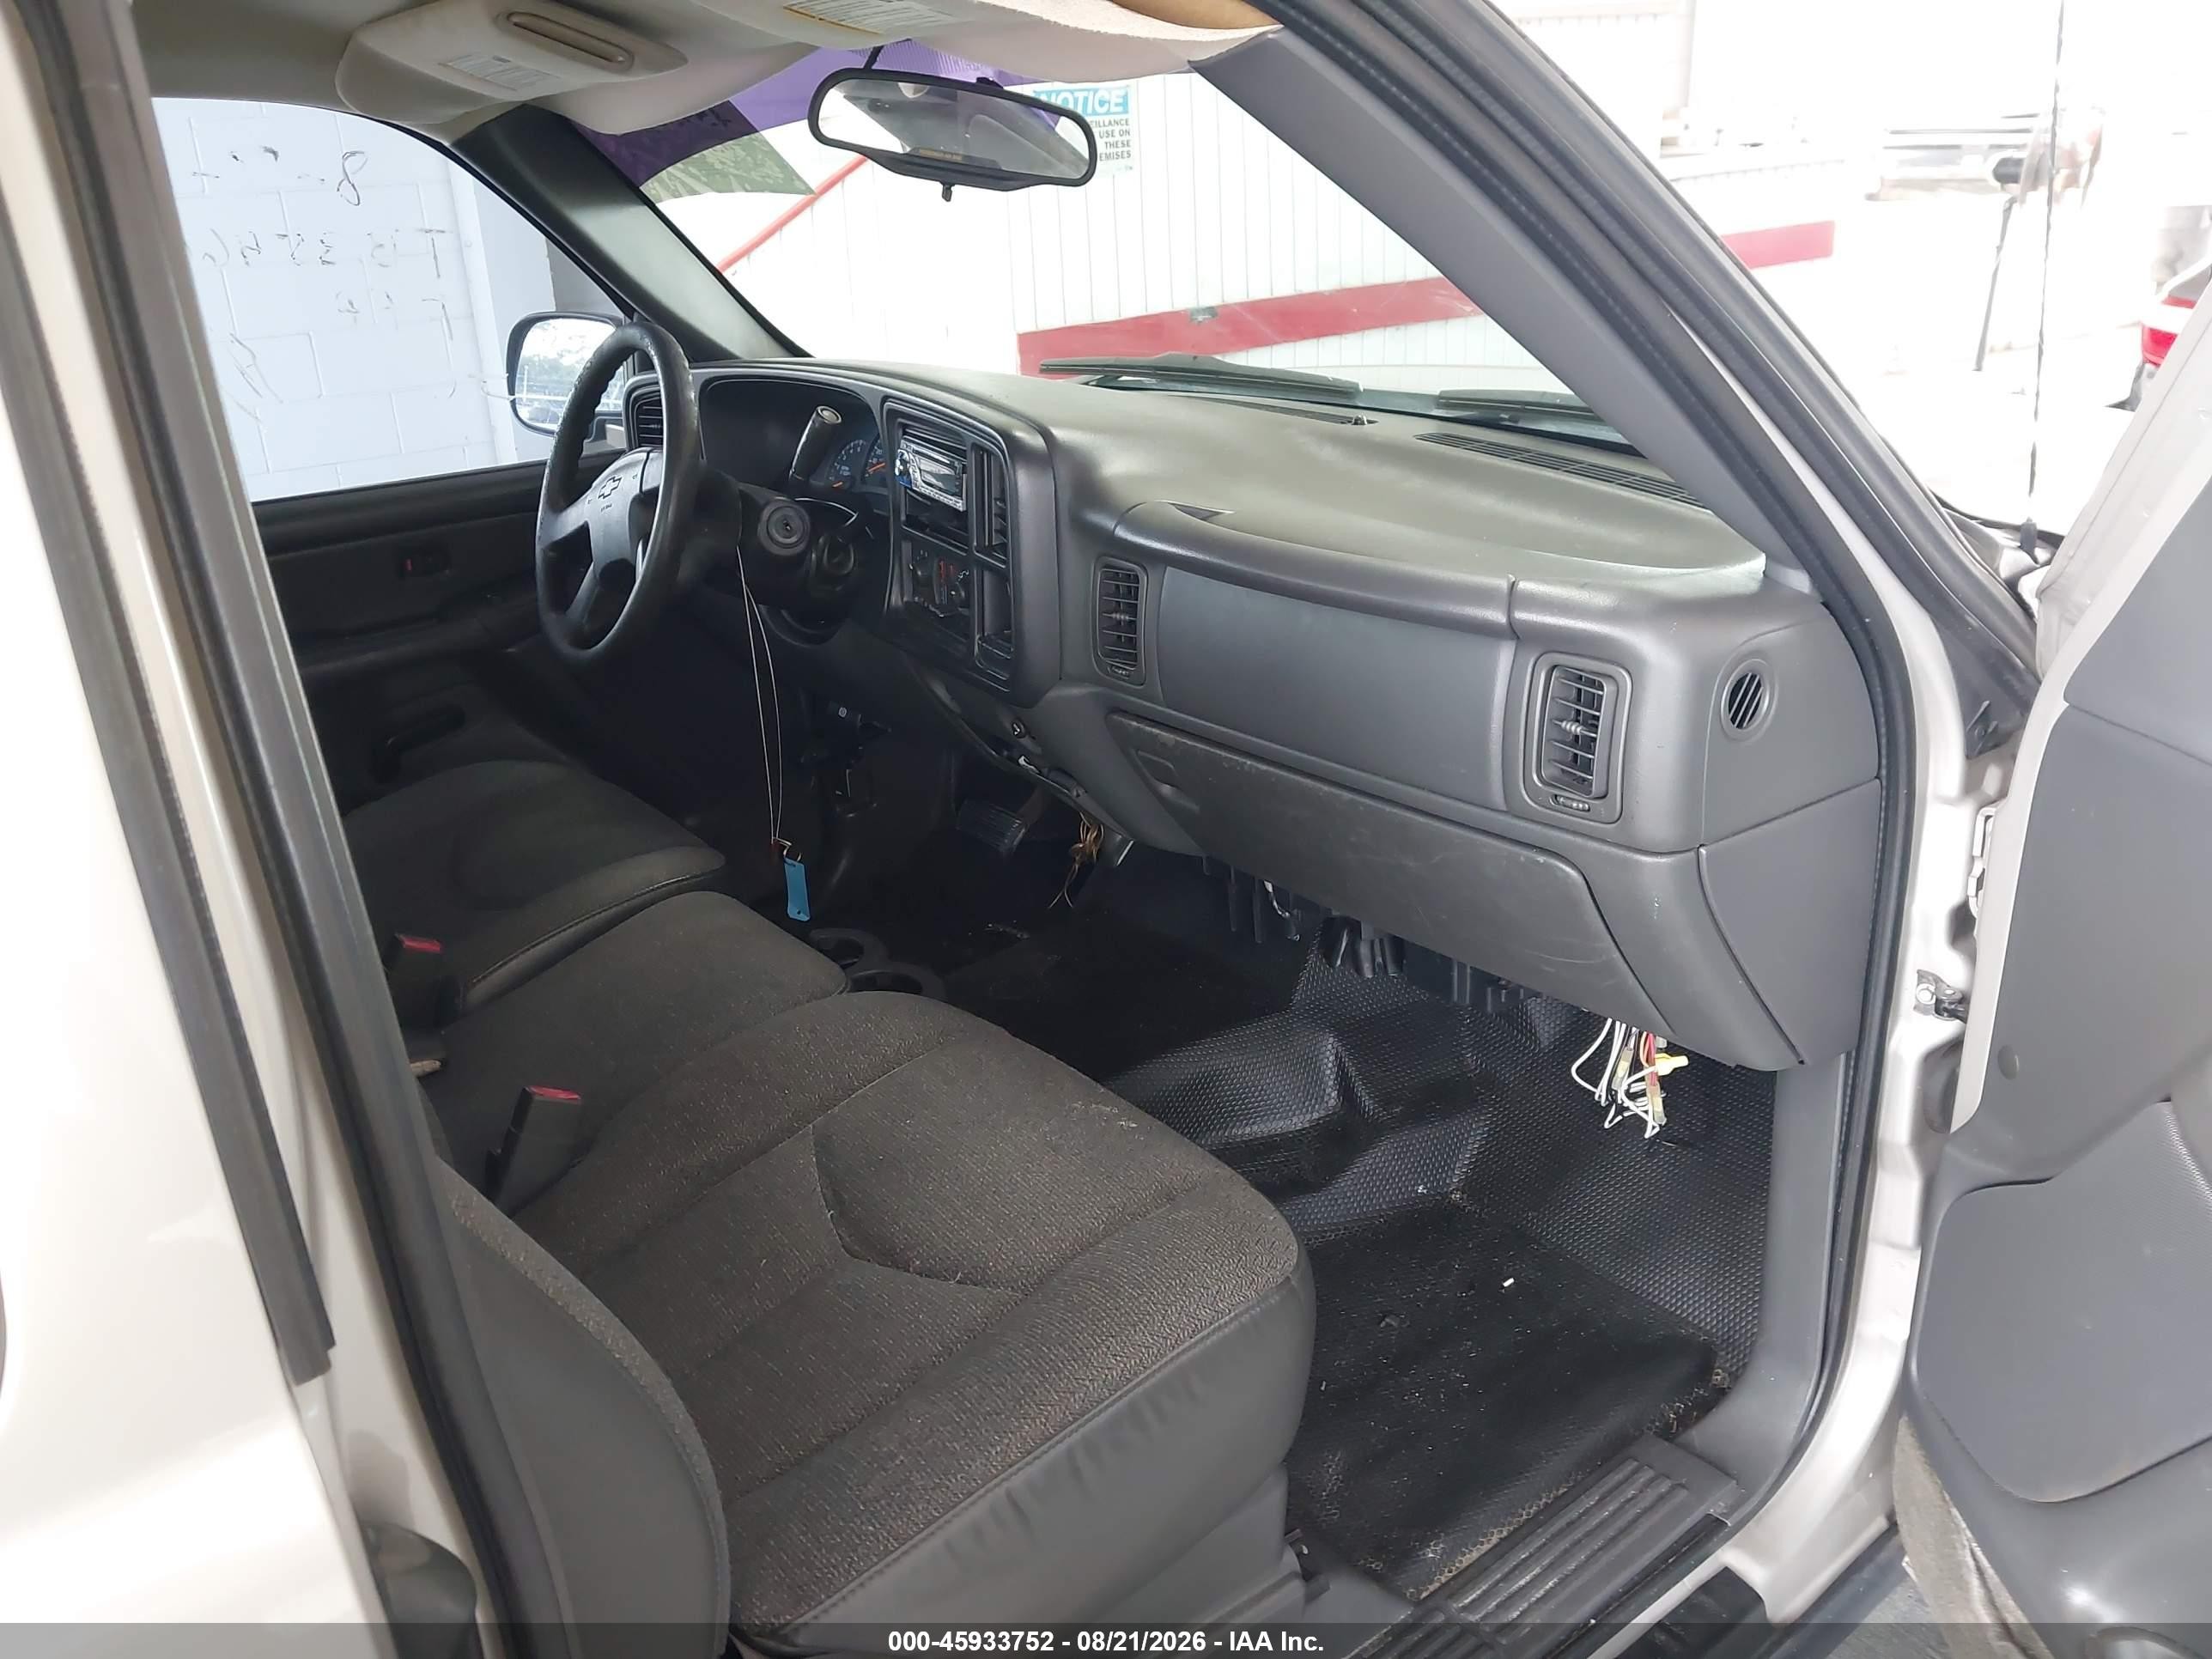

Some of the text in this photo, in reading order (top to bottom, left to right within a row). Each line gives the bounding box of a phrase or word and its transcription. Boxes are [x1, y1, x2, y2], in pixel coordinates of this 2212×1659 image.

[1091, 118, 1130, 129] EILLANCE
[1099, 128, 1131, 139] USE ON
[1104, 139, 1131, 149] THESE
[1098, 149, 1132, 161] EMISES
